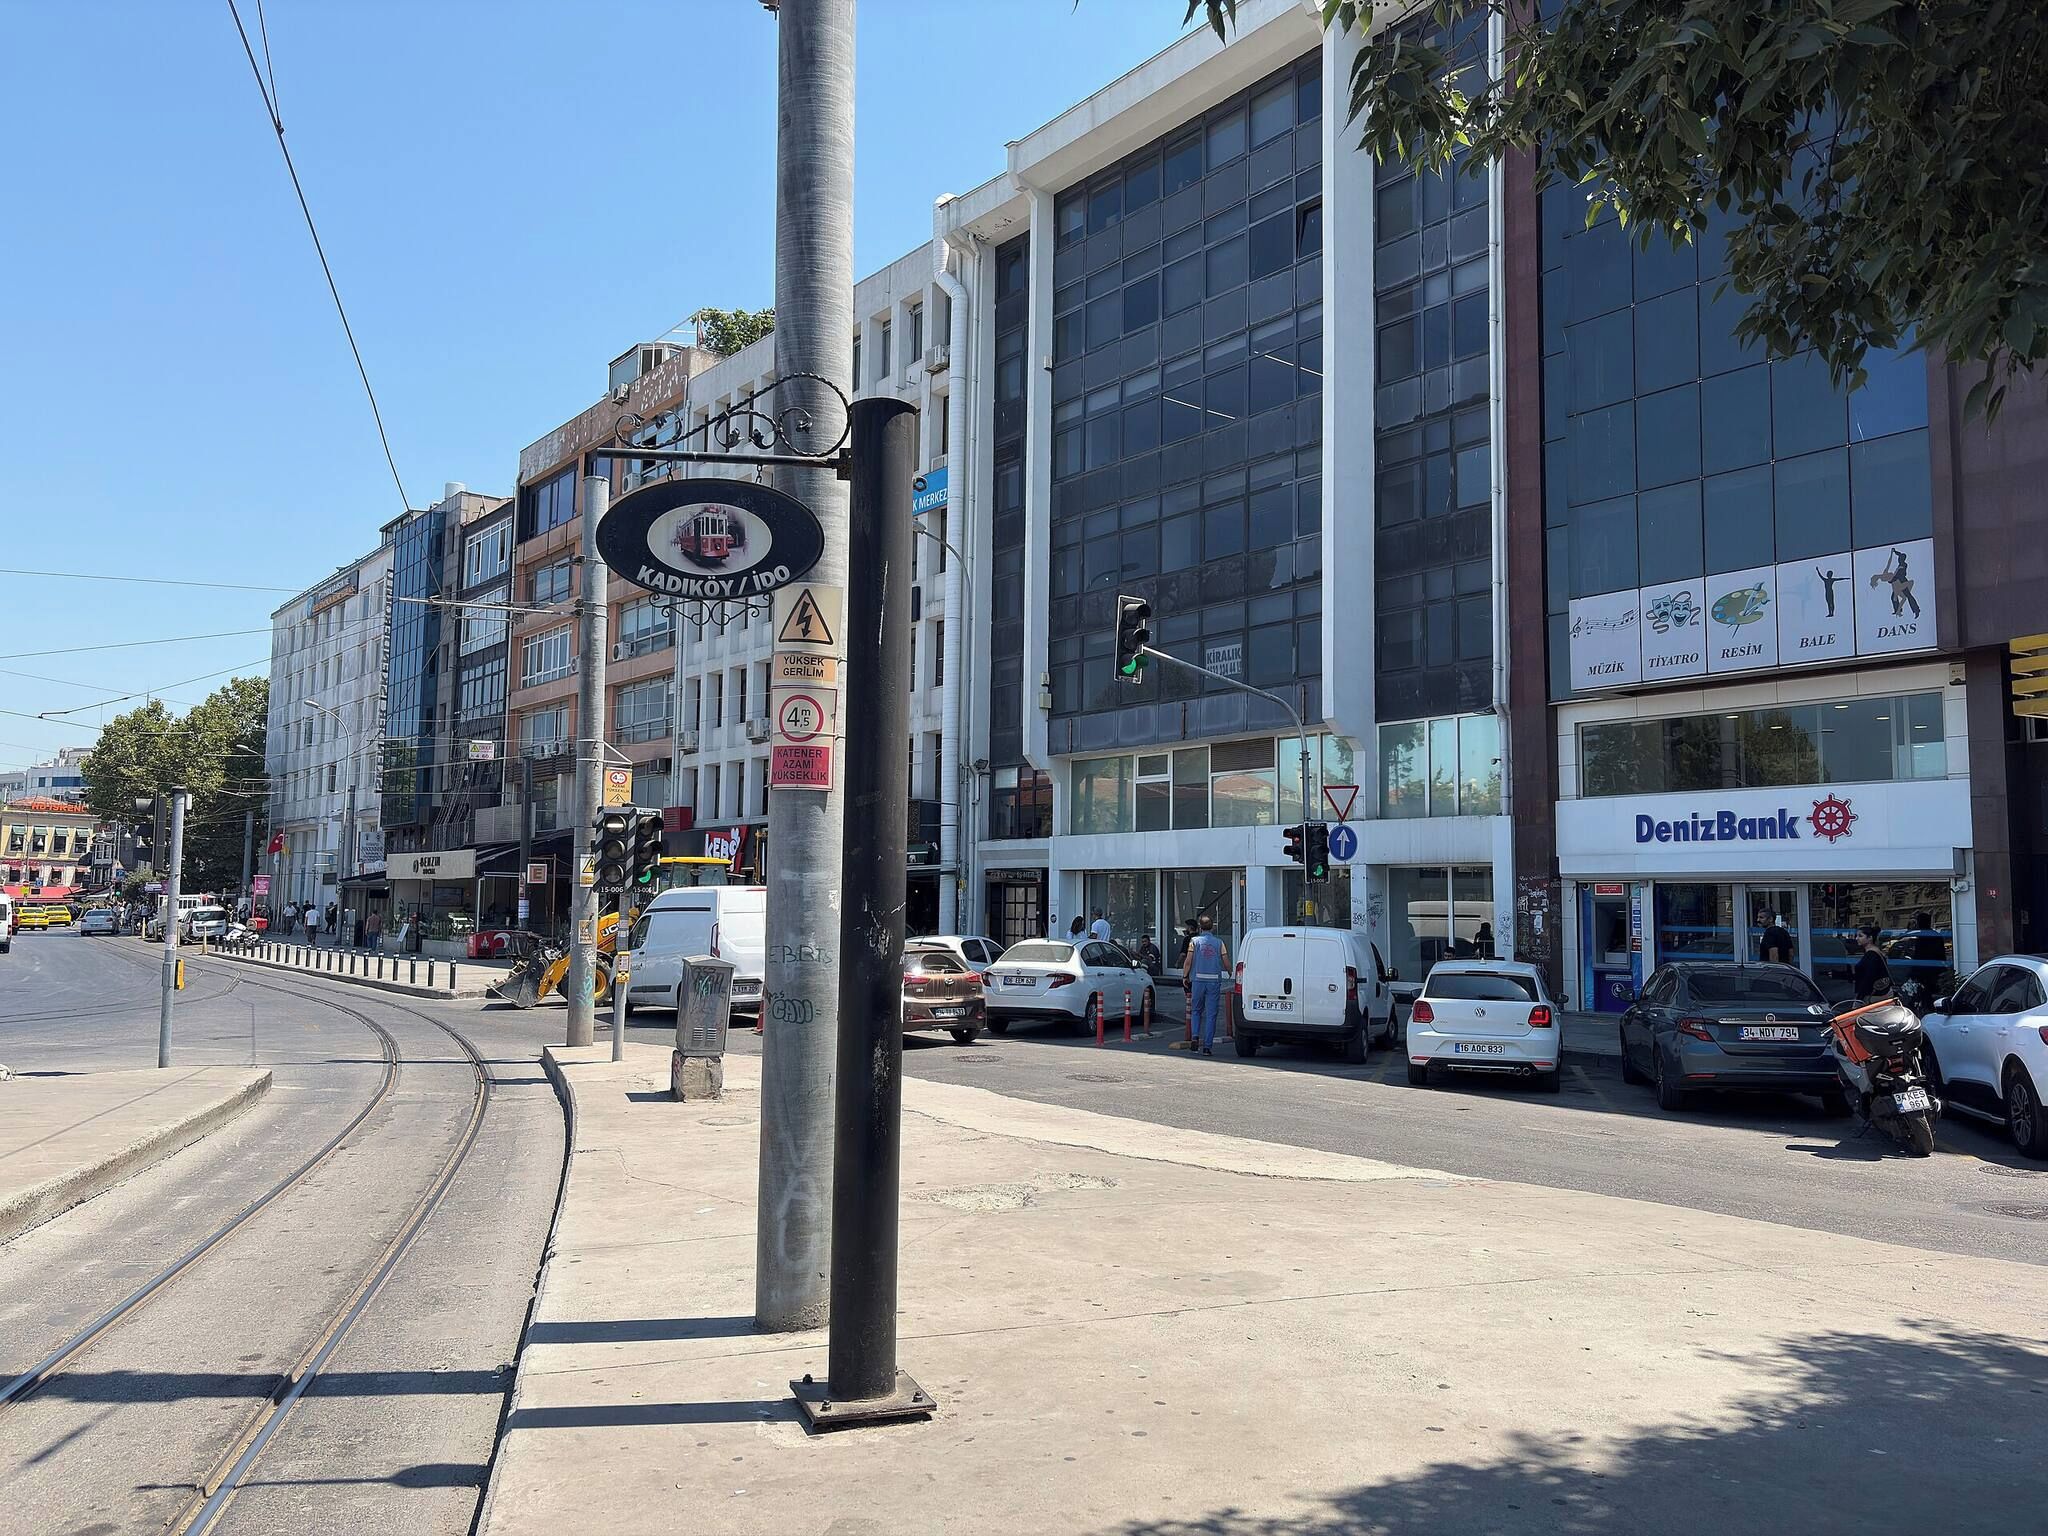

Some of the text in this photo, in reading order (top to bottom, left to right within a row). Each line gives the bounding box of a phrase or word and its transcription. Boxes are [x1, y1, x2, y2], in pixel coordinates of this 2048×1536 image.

[636, 565, 734, 597] KADIKÖY
[752, 565, 791, 591] İDO
[1877, 623, 1917, 639] DANS
[1799, 633, 1836, 649] BALE
[1206, 648, 1241, 665] KİRALIK
[1720, 642, 1762, 659] RESİM
[783, 655, 825, 666] YÜKSEK
[1648, 653, 1699, 668] TİYATRO
[783, 666, 824, 678] GERİLİM
[1587, 661, 1625, 676] MÜZİK
[777, 748, 823, 759] KATENER
[783, 759, 814, 769] AZAMİ
[772, 770, 827, 781] YÜKSEKLİK
[1635, 808, 1801, 843] DenizBank
[1257, 1001, 1265, 1009] 34
[1743, 1028, 1797, 1037] 34 NDY 794
[1460, 1044, 1469, 1052] 16
[1488, 1045, 1503, 1053] 833
[1907, 1090, 1926, 1100] KES
